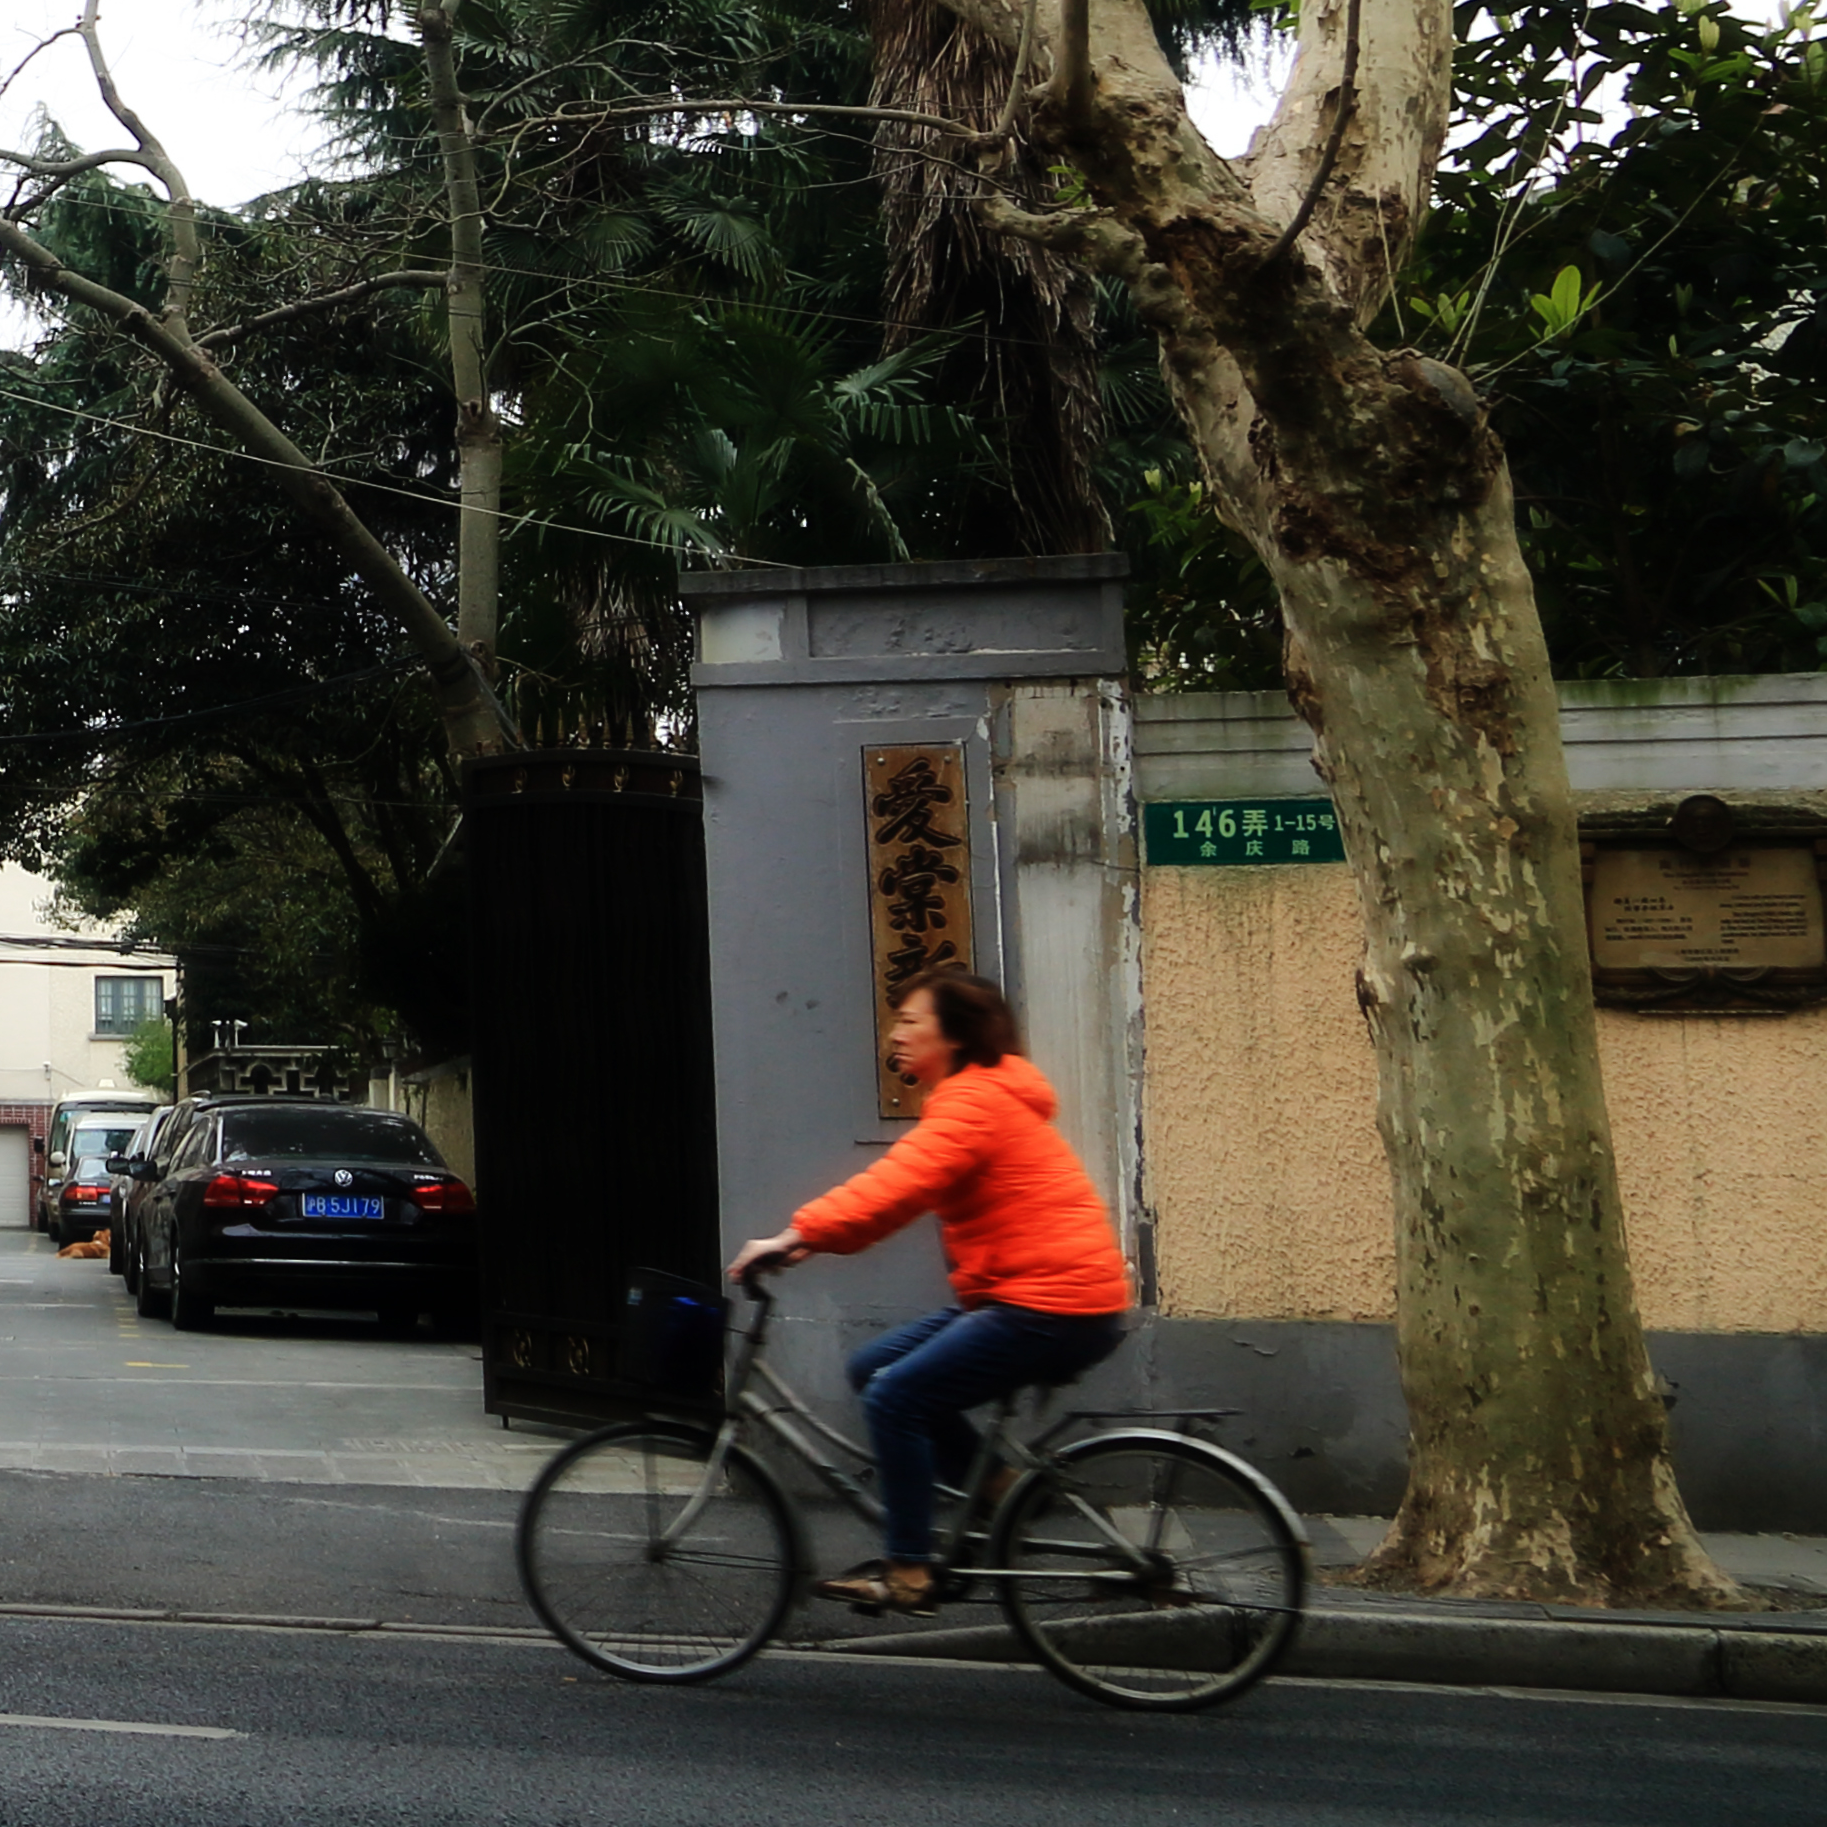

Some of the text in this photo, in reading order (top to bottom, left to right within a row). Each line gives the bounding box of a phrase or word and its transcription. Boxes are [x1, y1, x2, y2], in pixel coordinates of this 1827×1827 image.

[1173, 809, 1336, 838] 146弄 1-15号
[1199, 839, 1311, 858] 余庆路
